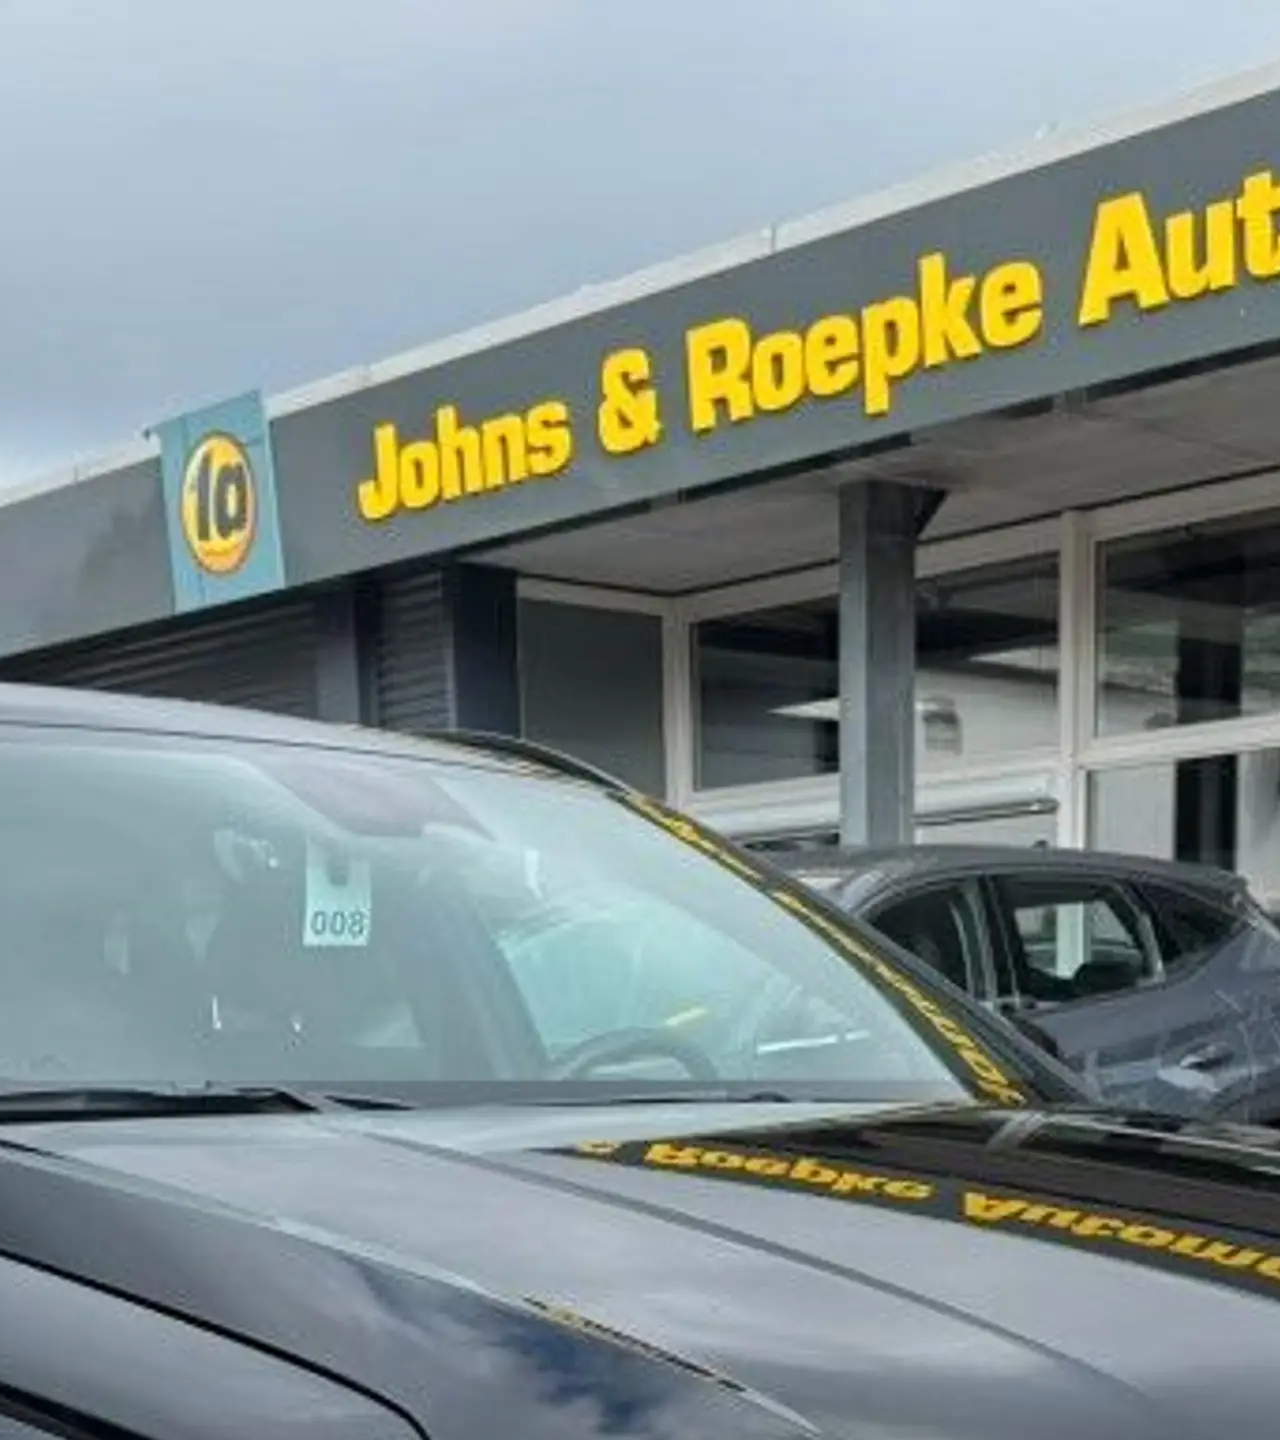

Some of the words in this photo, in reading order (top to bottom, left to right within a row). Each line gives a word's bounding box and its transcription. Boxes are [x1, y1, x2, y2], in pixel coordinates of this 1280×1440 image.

[358, 402, 575, 521] Johns
[598, 350, 662, 454] &
[686, 255, 1044, 431] Roepke
[310, 910, 365, 936] 008
